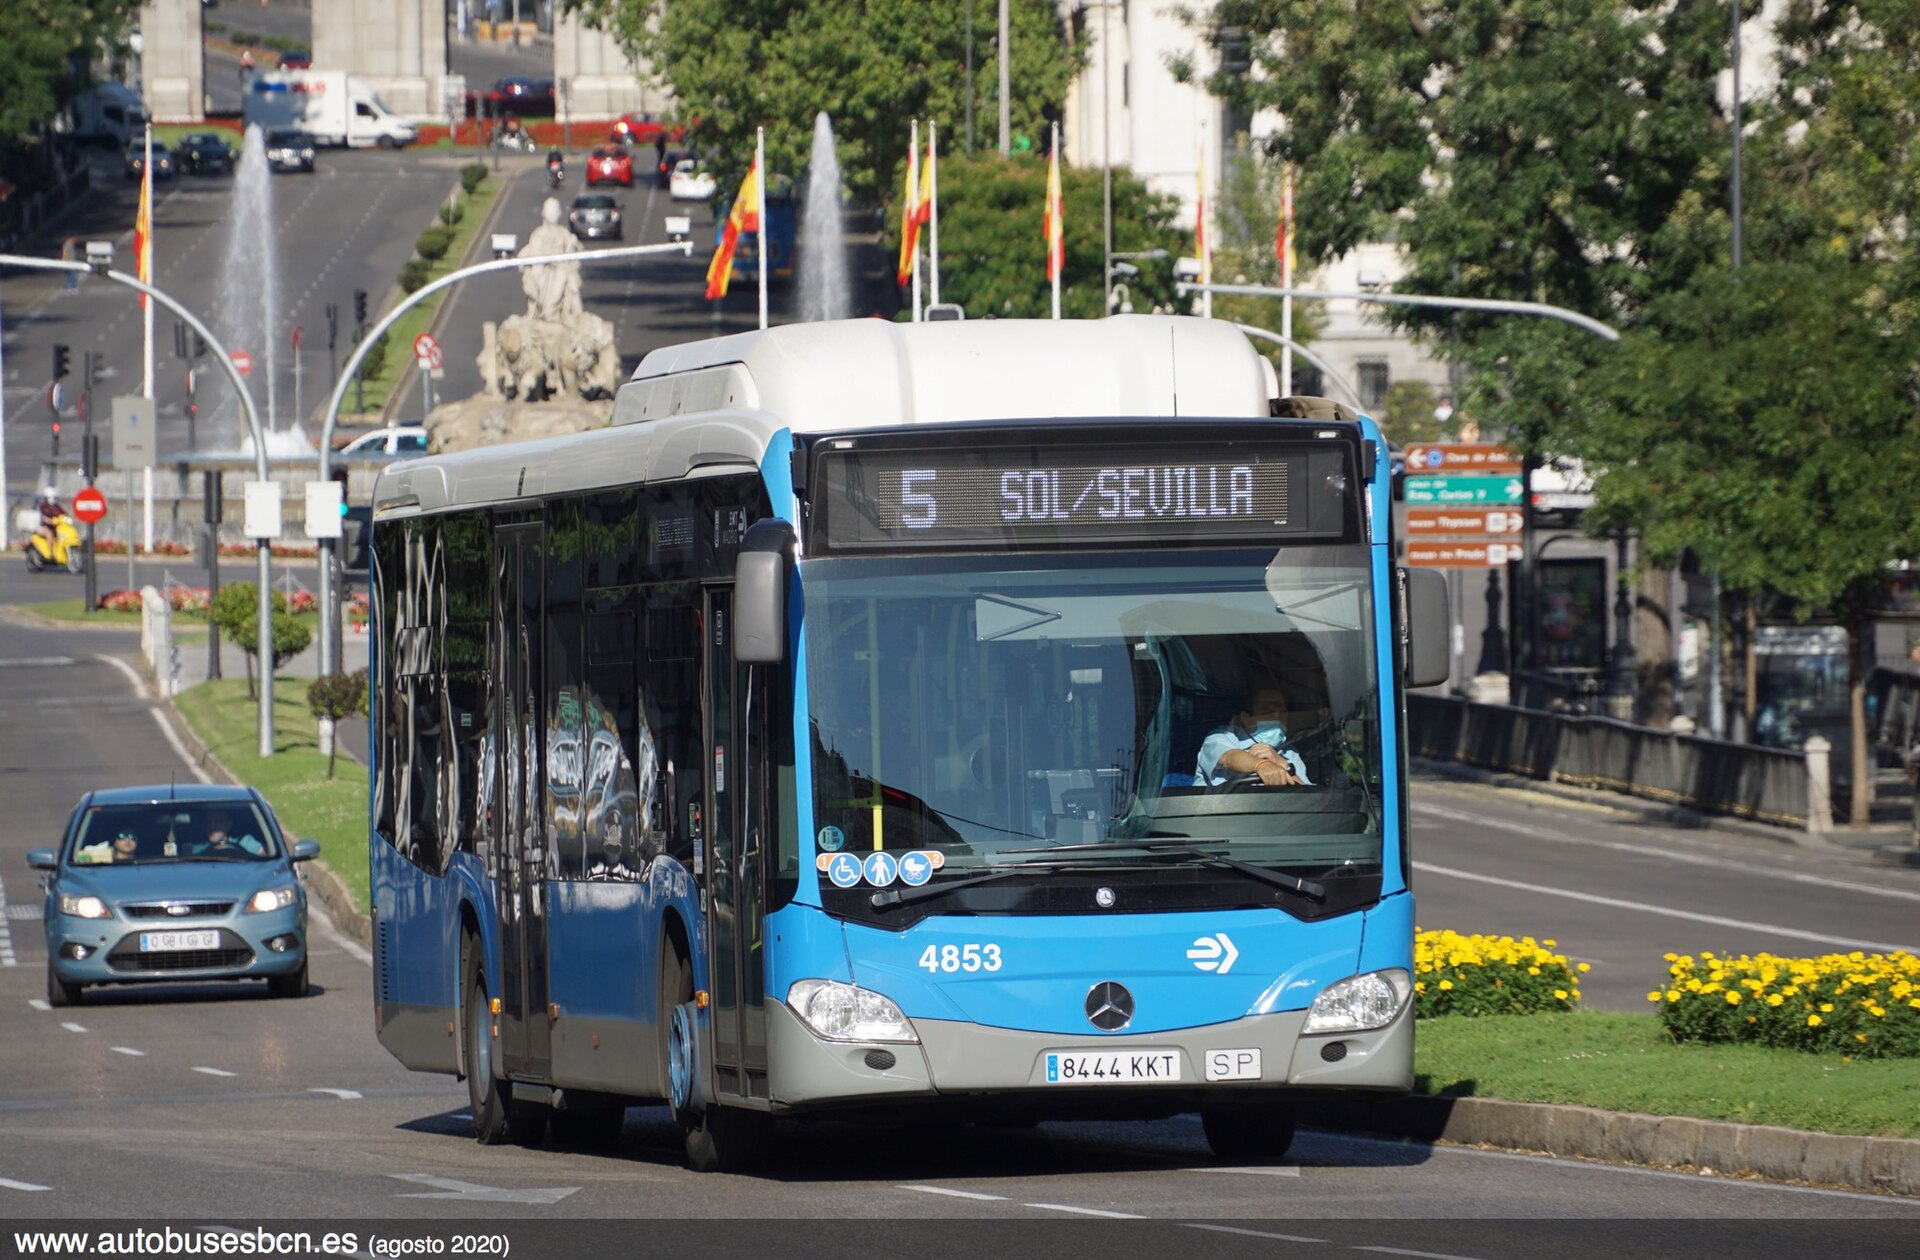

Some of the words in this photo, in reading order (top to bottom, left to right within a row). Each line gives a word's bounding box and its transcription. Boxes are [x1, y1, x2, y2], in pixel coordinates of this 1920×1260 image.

[901, 469, 937, 529] 5
[1001, 466, 1254, 519] SOL/SEVILLA
[919, 943, 1003, 973] 4853
[1062, 1056, 1122, 1079] 8444
[1131, 1056, 1173, 1078] KKT
[1213, 1053, 1254, 1076] SP
